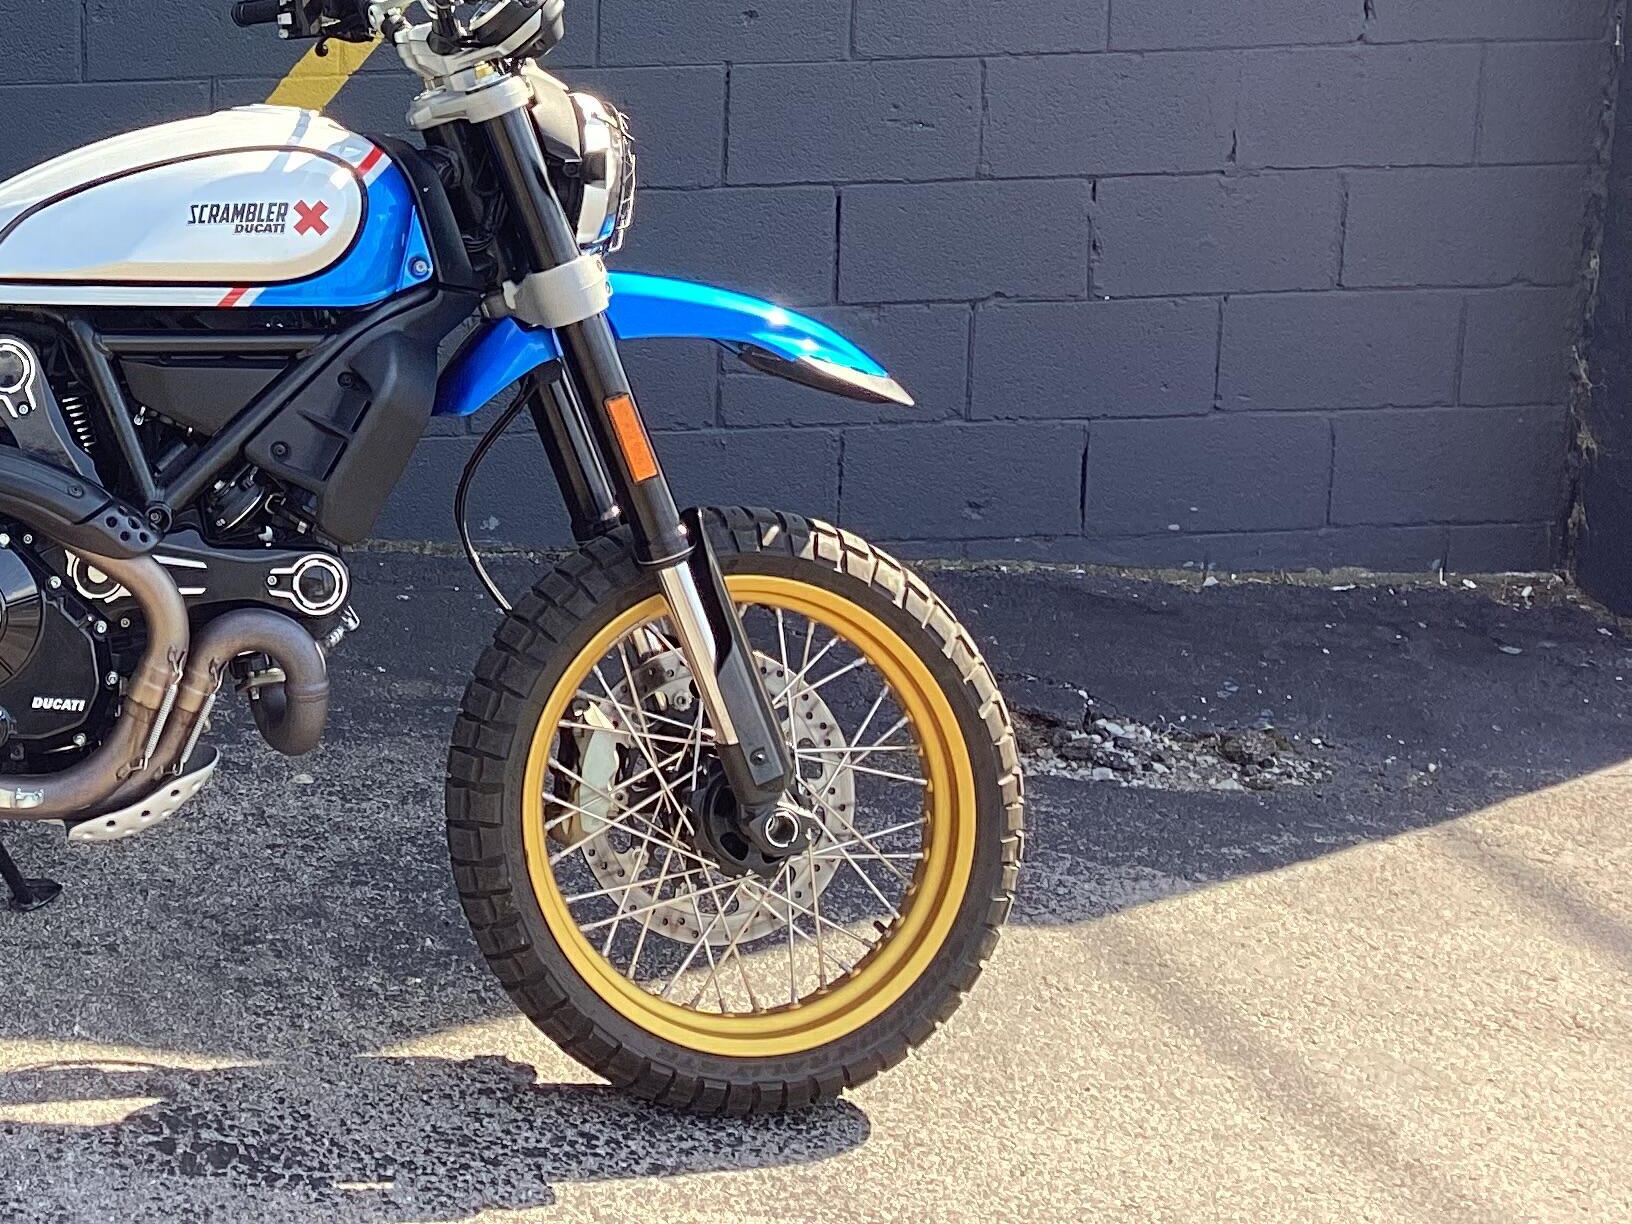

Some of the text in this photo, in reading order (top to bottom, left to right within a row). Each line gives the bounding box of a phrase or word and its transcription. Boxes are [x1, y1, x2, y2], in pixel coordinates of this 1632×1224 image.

[187, 202, 289, 225] SCRAMBLER
[234, 223, 286, 234] DUCATI
[31, 696, 86, 712] DUCATI
